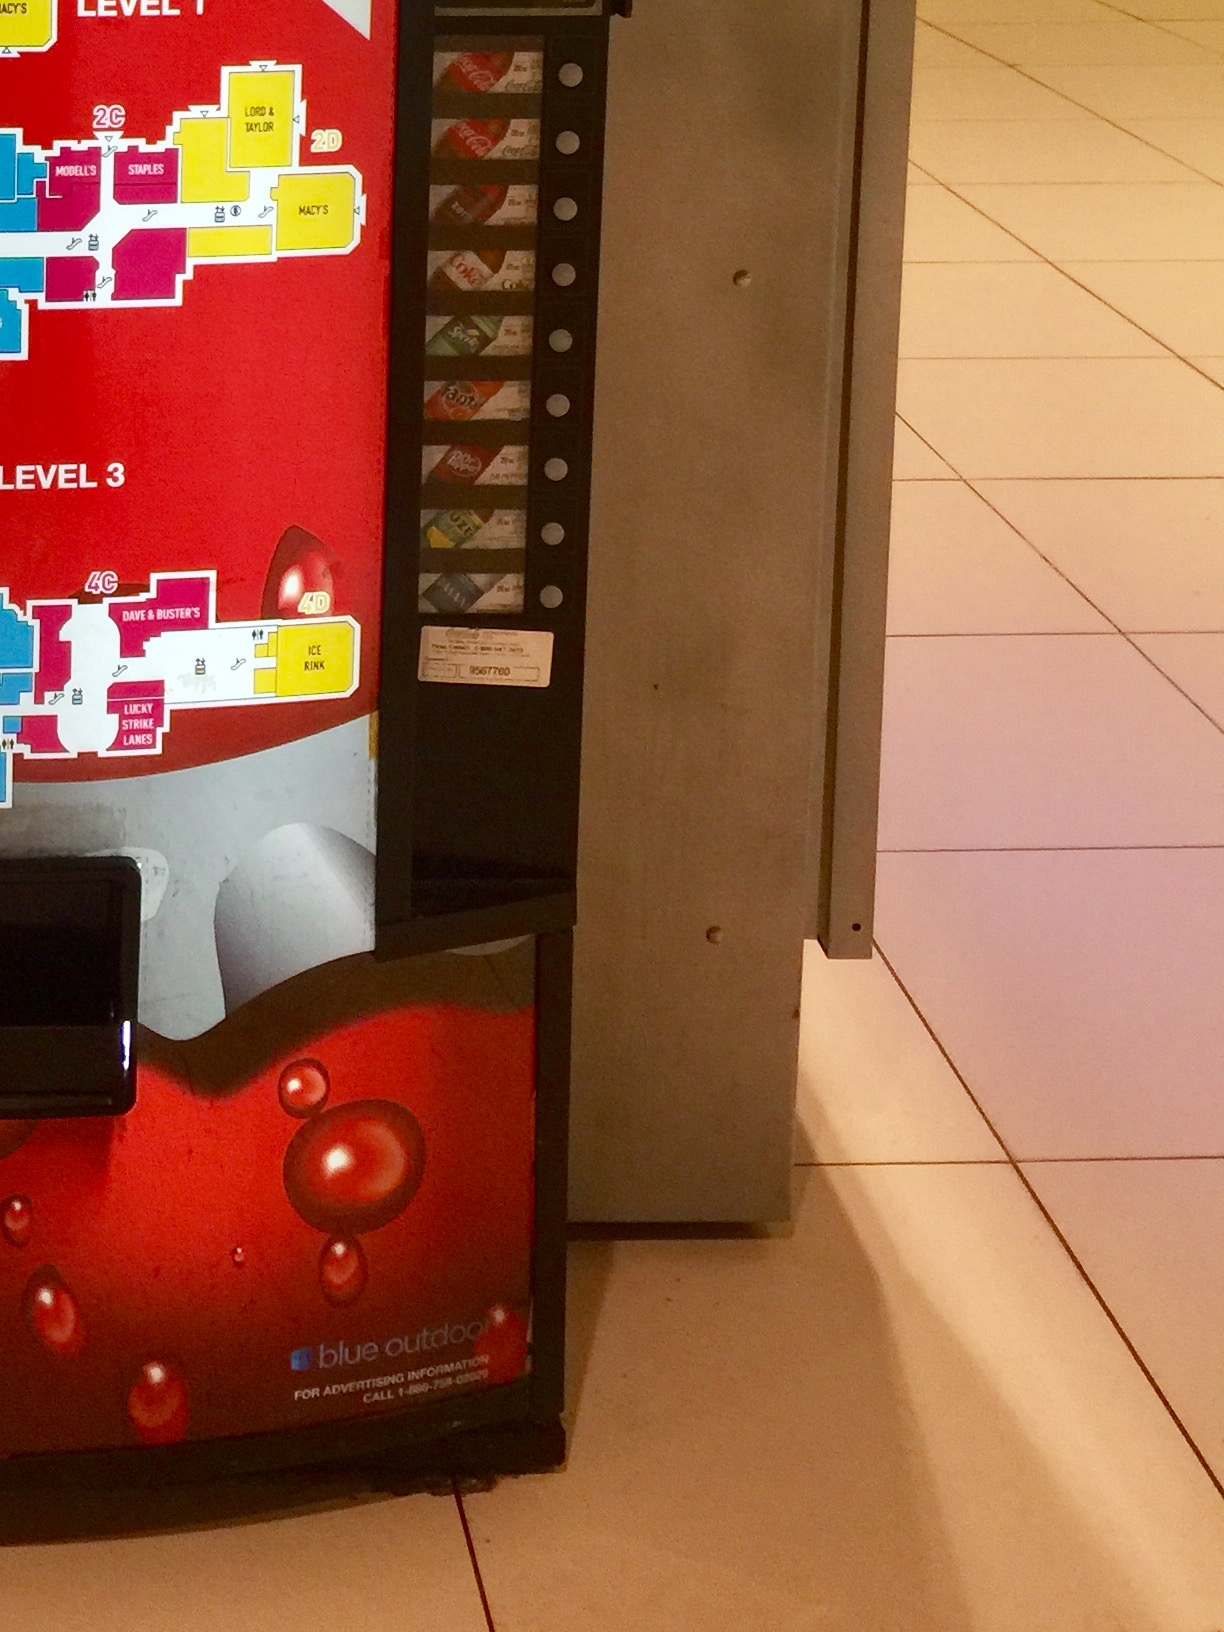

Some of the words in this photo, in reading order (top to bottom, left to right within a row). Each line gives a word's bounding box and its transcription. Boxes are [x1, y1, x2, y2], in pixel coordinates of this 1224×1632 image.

[94, 106, 124, 127] 2C
[244, 106, 266, 117] LORD
[245, 122, 274, 132] TAYLOR
[311, 130, 341, 152] 2D
[55, 164, 97, 176] MODELL'S
[128, 163, 164, 175] STAPLES
[298, 205, 329, 216] MACY'S
[106, 462, 125, 487] 3
[86, 572, 118, 593] 4C
[299, 592, 329, 614] 4D
[122, 610, 145, 621] DAVE
[147, 610, 155, 620] &
[156, 607, 201, 620] BUSTER'S
[308, 645, 321, 656] ICE
[304, 660, 325, 671] RINK
[124, 703, 154, 715] LUCKY
[122, 718, 154, 730] STRIKE
[123, 734, 152, 745] LANES
[319, 1340, 379, 1368] blue
[294, 1389, 320, 1401] FOR
[323, 1373, 404, 1397] ADVERTISING
[407, 1354, 490, 1382] INFORMATION
[362, 1390, 394, 1404] CALL
